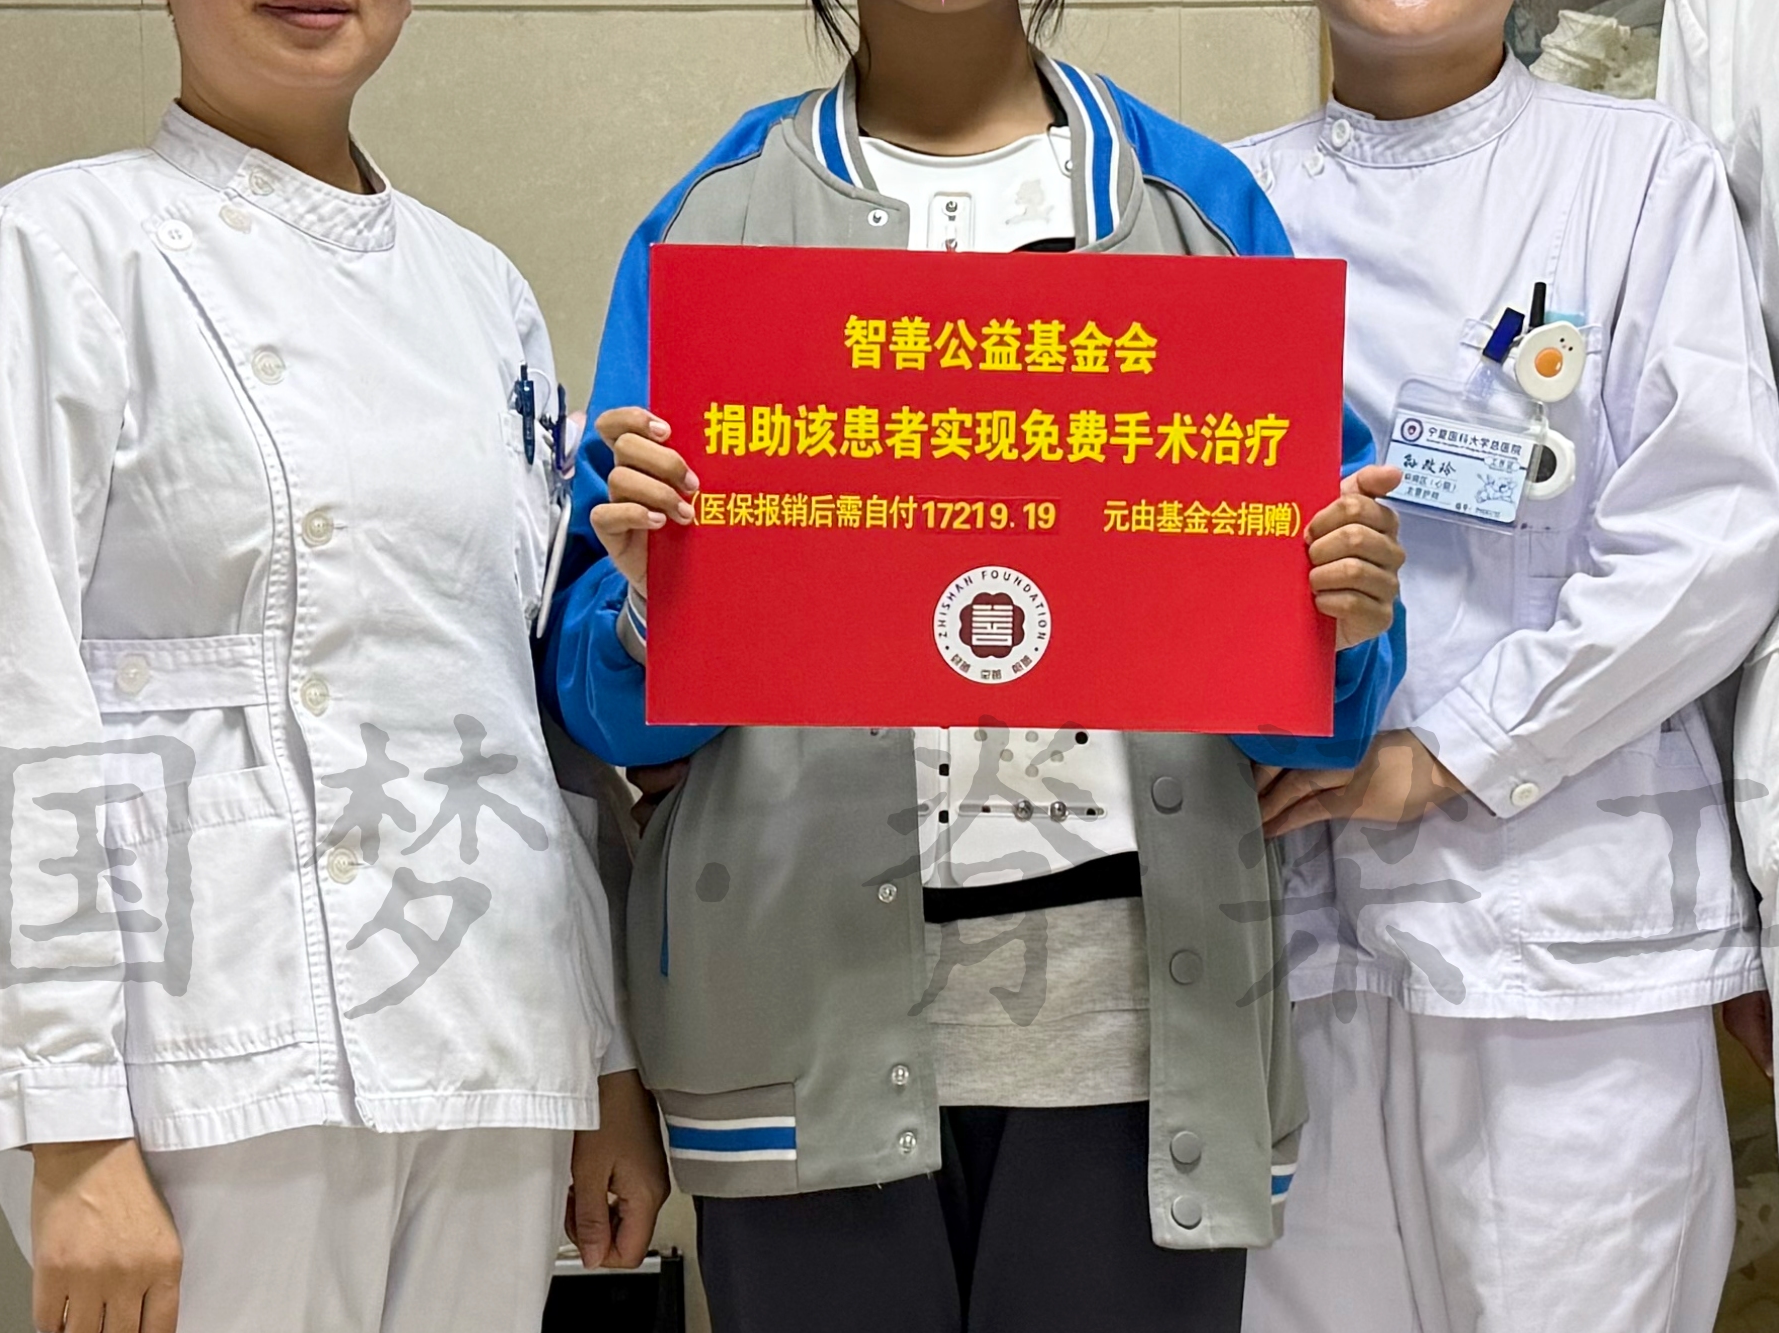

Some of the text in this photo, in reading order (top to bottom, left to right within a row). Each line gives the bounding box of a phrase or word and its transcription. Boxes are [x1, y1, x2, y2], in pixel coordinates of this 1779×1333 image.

[843, 313, 1159, 375] 智善公益基金会
[703, 401, 1291, 468] 捐助该患者实现免费手术治疗
[937, 569, 1048, 640] ZHISHAN FOUNDATION
